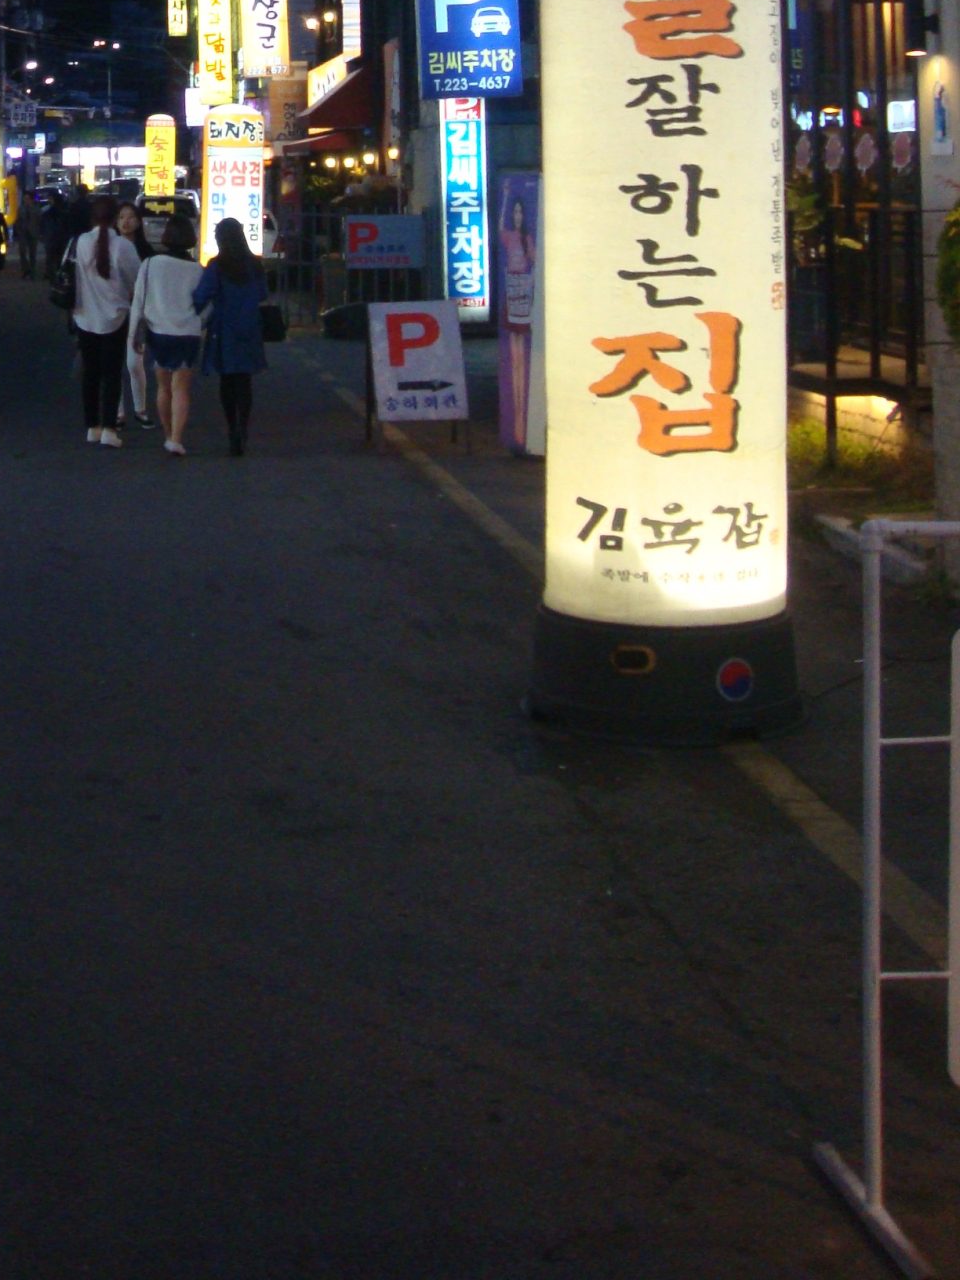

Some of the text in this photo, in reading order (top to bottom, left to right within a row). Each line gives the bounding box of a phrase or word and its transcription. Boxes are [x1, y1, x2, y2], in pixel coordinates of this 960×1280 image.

[428, 48, 516, 75] 김씨주차장
[434, 75, 511, 92] T.223-4637
[448, 122, 483, 294] 김씨주차장
[617, 64, 722, 308] 잘하는
[348, 223, 380, 254] P
[385, 312, 440, 367] P
[588, 312, 742, 456] 집
[575, 496, 769, 554] 김육갑
